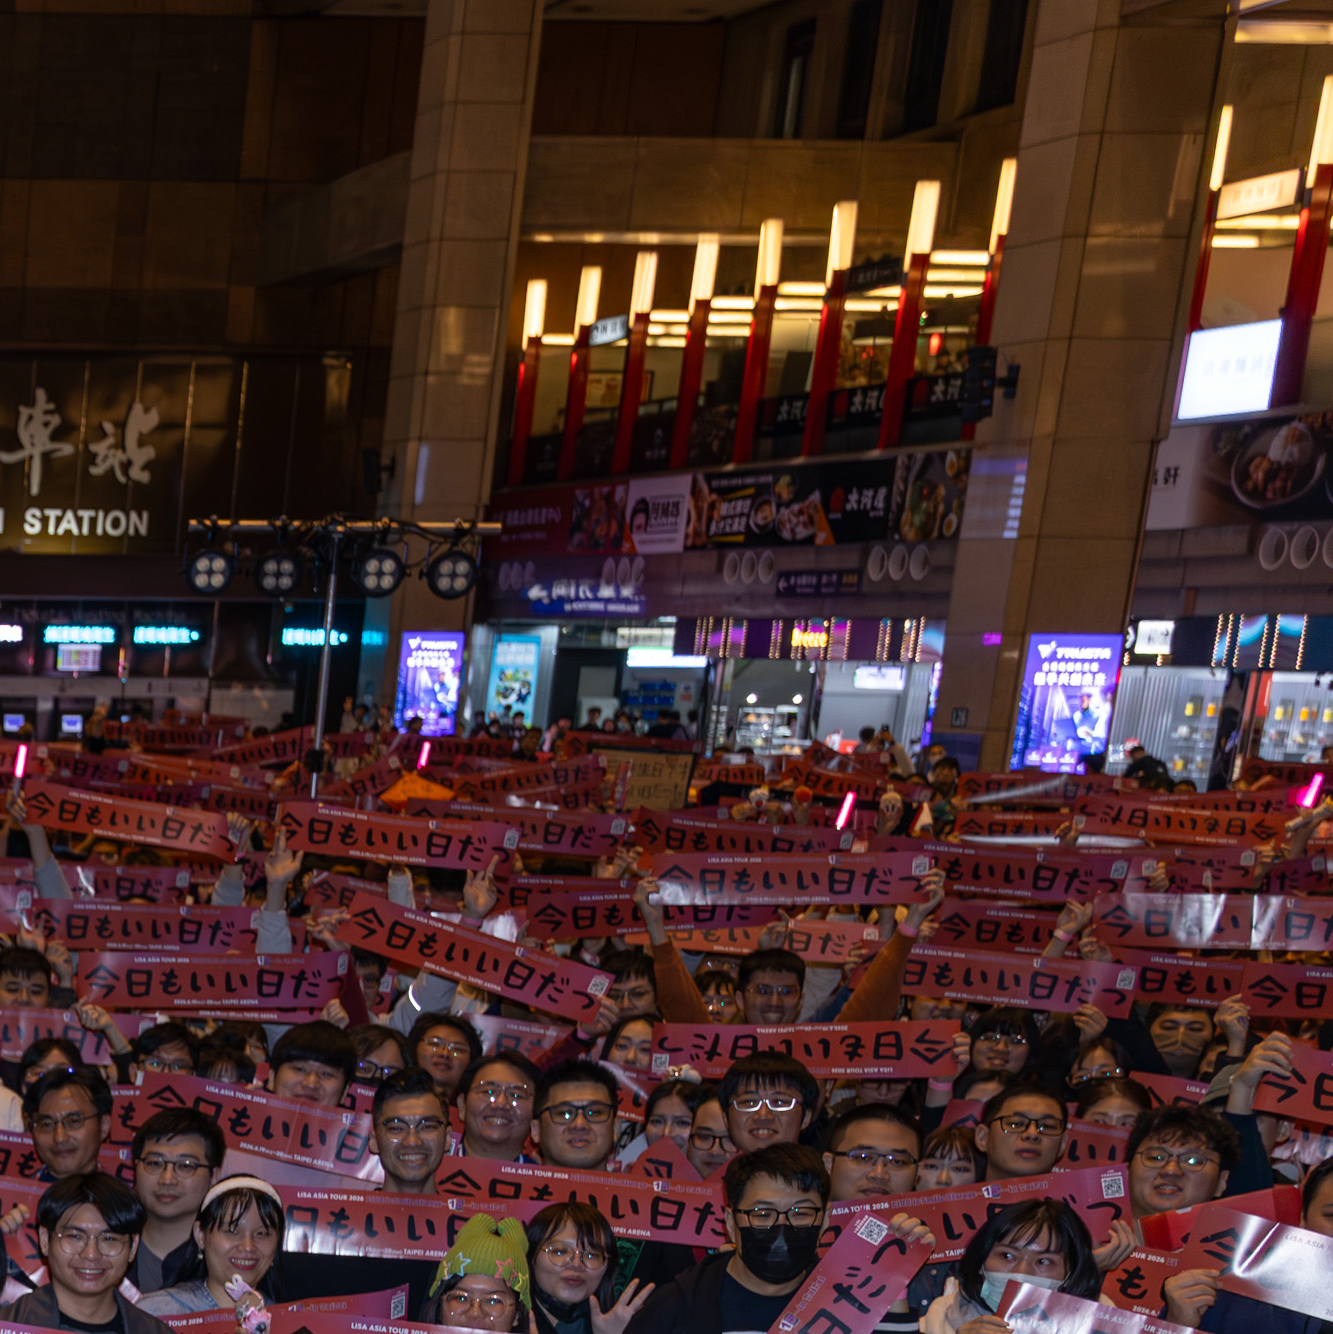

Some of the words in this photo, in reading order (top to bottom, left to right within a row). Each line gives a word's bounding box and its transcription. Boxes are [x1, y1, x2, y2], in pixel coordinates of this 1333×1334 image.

[23, 508, 150, 538] STATION
[27, 790, 235, 850] 今日もいい日だっ
[279, 812, 510, 863] 今日もいい日だっ
[658, 864, 923, 898] 今日もいい日だっ
[36, 908, 256, 942] 今日もいい日だっ
[353, 908, 596, 1011] 今日もいい日だっ
[84, 965, 345, 1000] 今日もいい日だっ
[147, 1084, 369, 1165] 今日もいい日
[871, 1202, 890, 1211] 2026
[351, 1321, 367, 1331] LiSA
